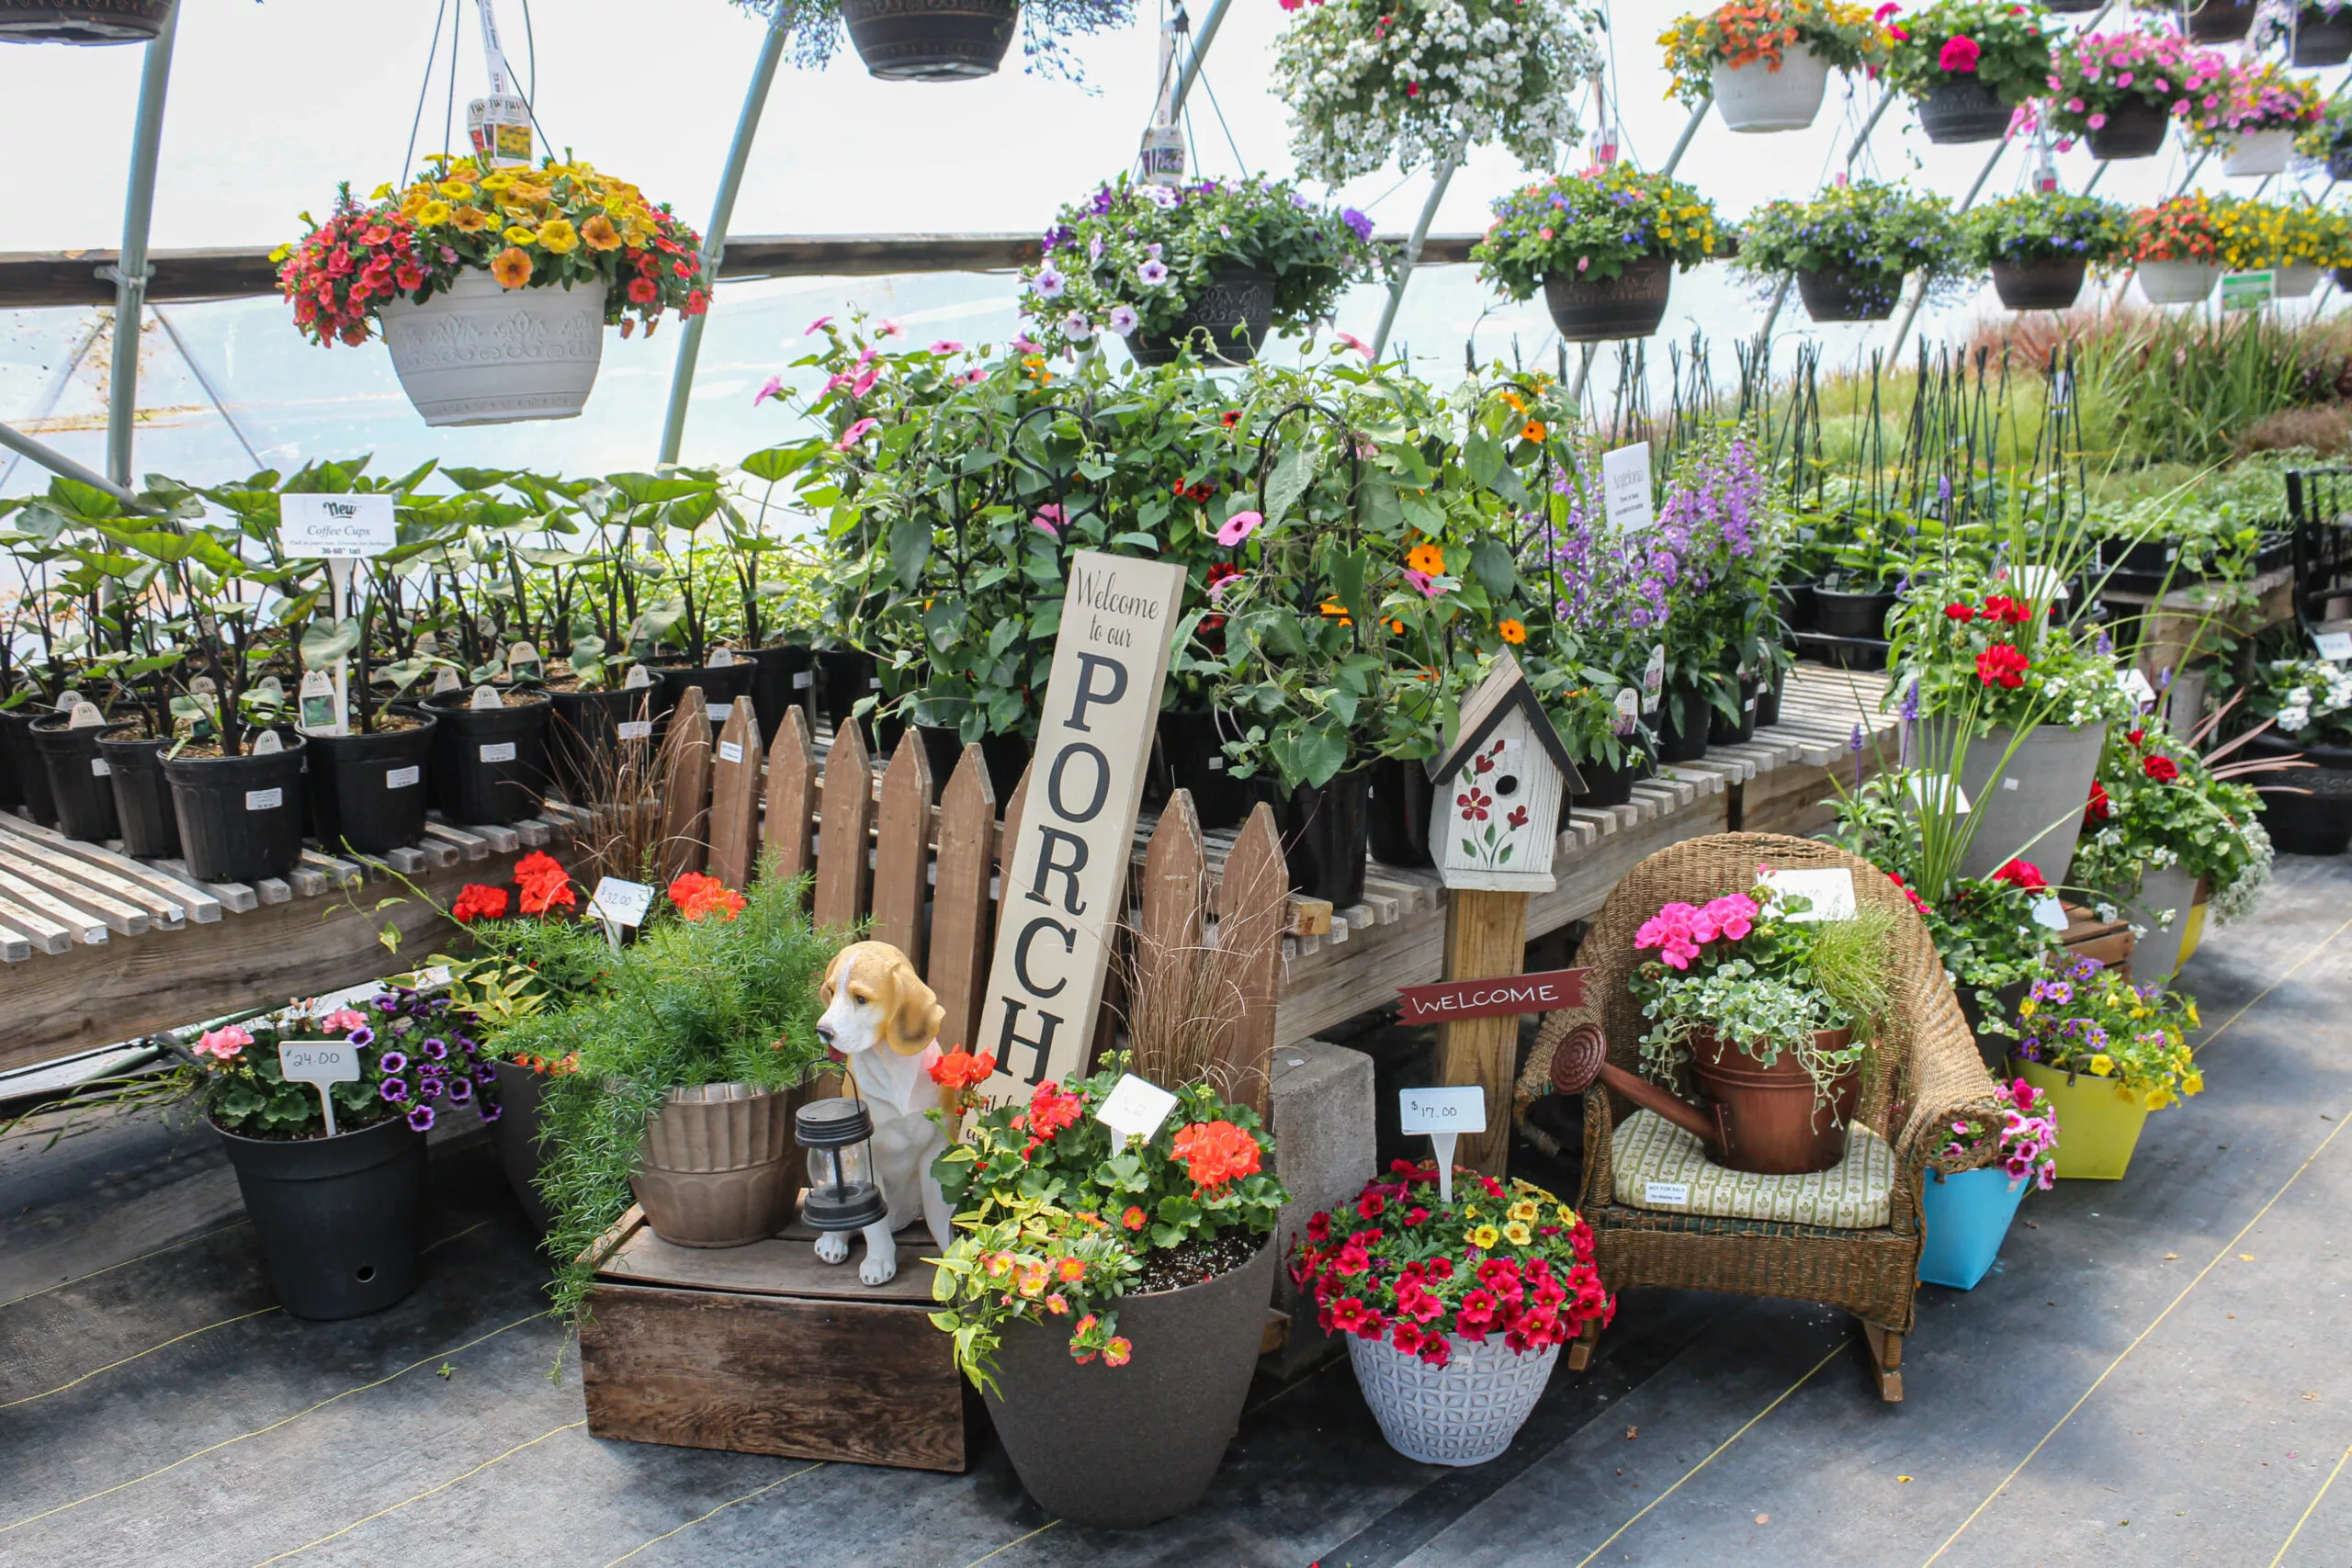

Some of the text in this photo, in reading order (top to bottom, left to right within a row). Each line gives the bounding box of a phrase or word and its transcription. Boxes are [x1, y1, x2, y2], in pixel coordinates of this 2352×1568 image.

[323, 502, 357, 516] New
[307, 525, 371, 537] Coffee Cups
[1077, 566, 1159, 620] Welcome
[1090, 614, 1132, 648] to our
[994, 651, 1128, 1087] PORCH
[1412, 985, 1559, 1015] WELCOME
[285, 1049, 340, 1067] $24.00
[1410, 1100, 1457, 1118] $17.00
